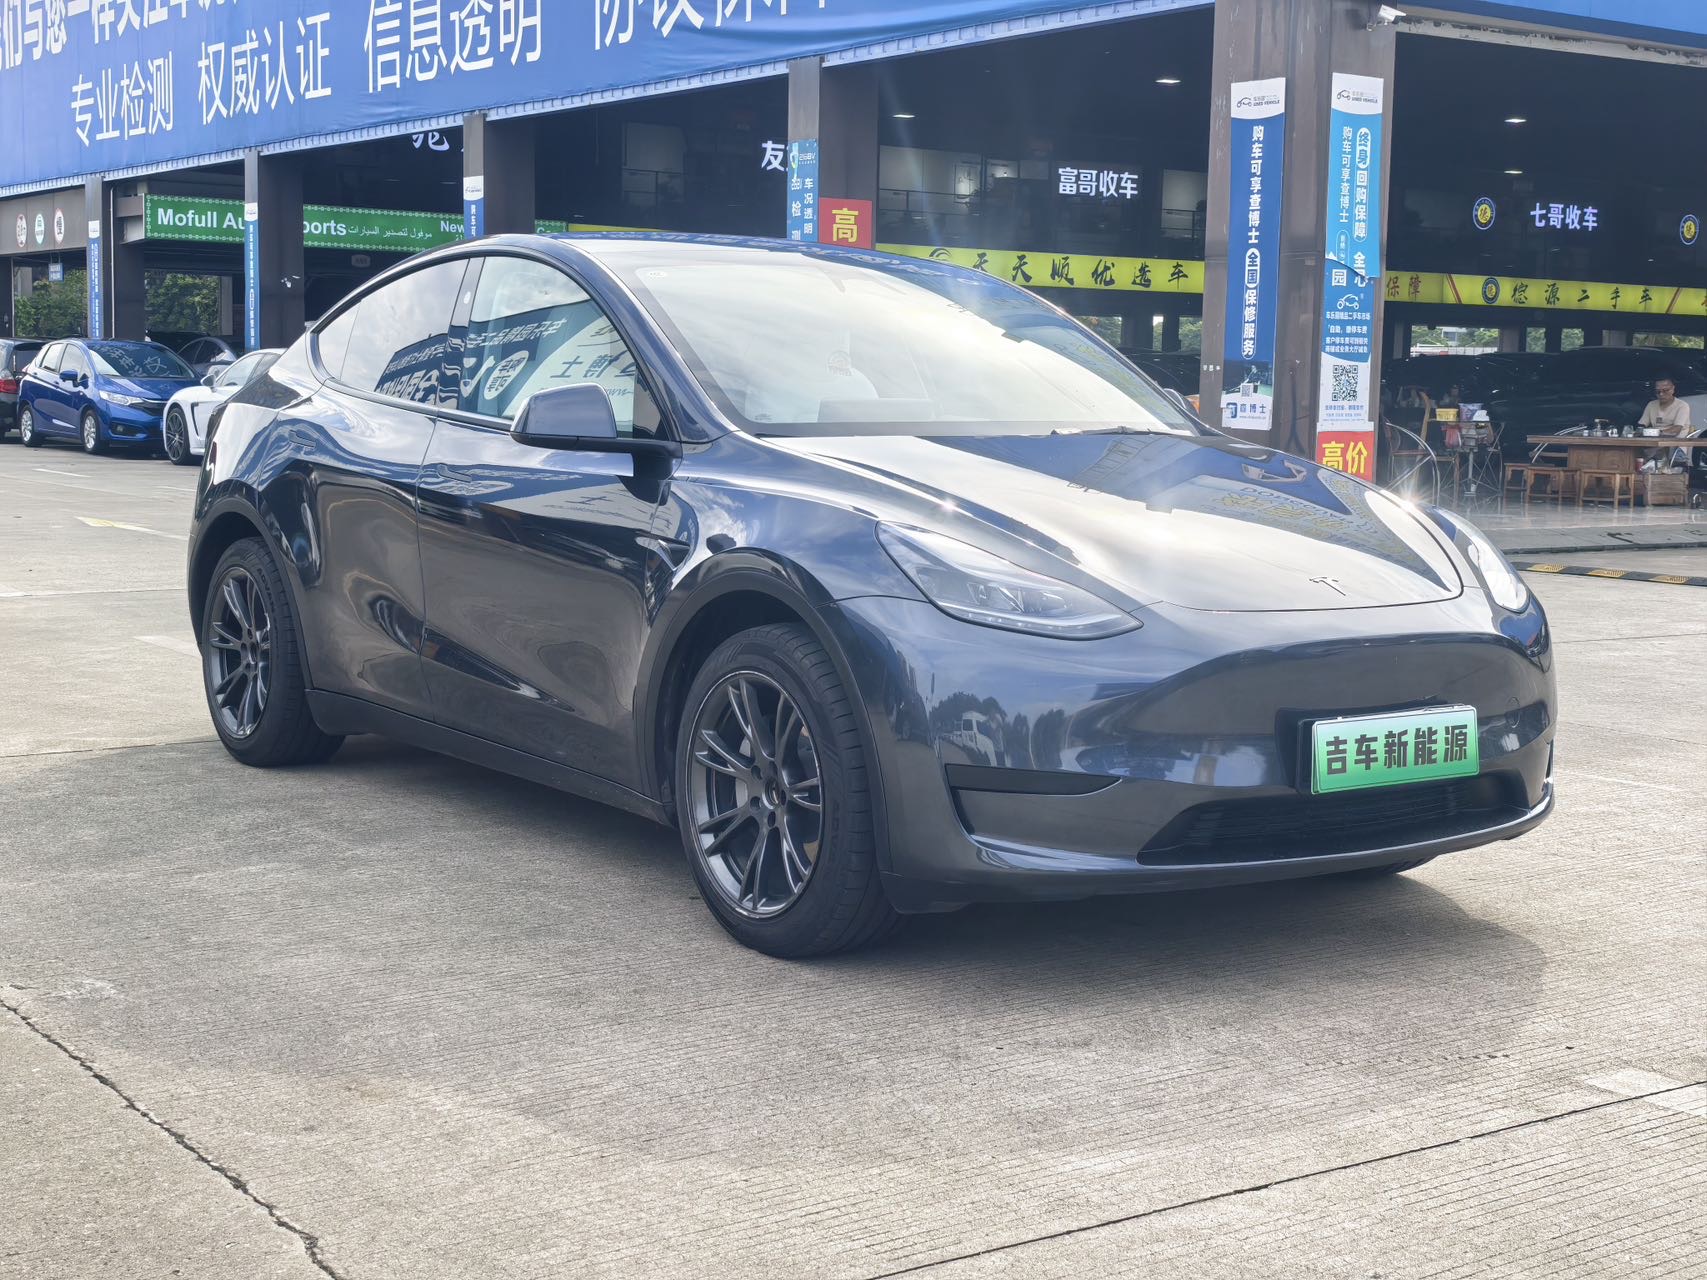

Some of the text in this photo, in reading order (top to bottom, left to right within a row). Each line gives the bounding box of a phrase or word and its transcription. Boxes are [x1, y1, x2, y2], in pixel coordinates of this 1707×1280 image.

[71, 50, 173, 147] 专业检测
[198, 12, 332, 125] 权威认证
[363, 0, 542, 93] 信息透明
[761, 140, 788, 172] 友
[1058, 167, 1139, 199] 富哥收车
[157, 208, 218, 229] Mofull
[222, 212, 246, 230] Au
[803, 178, 814, 235] 车况透明
[1530, 202, 1598, 231] 七哥收车
[831, 207, 859, 243] 高
[1386, 275, 1421, 300] 保障
[1321, 441, 1368, 474] 高价
[1325, 724, 1468, 775] 吉车新能源
